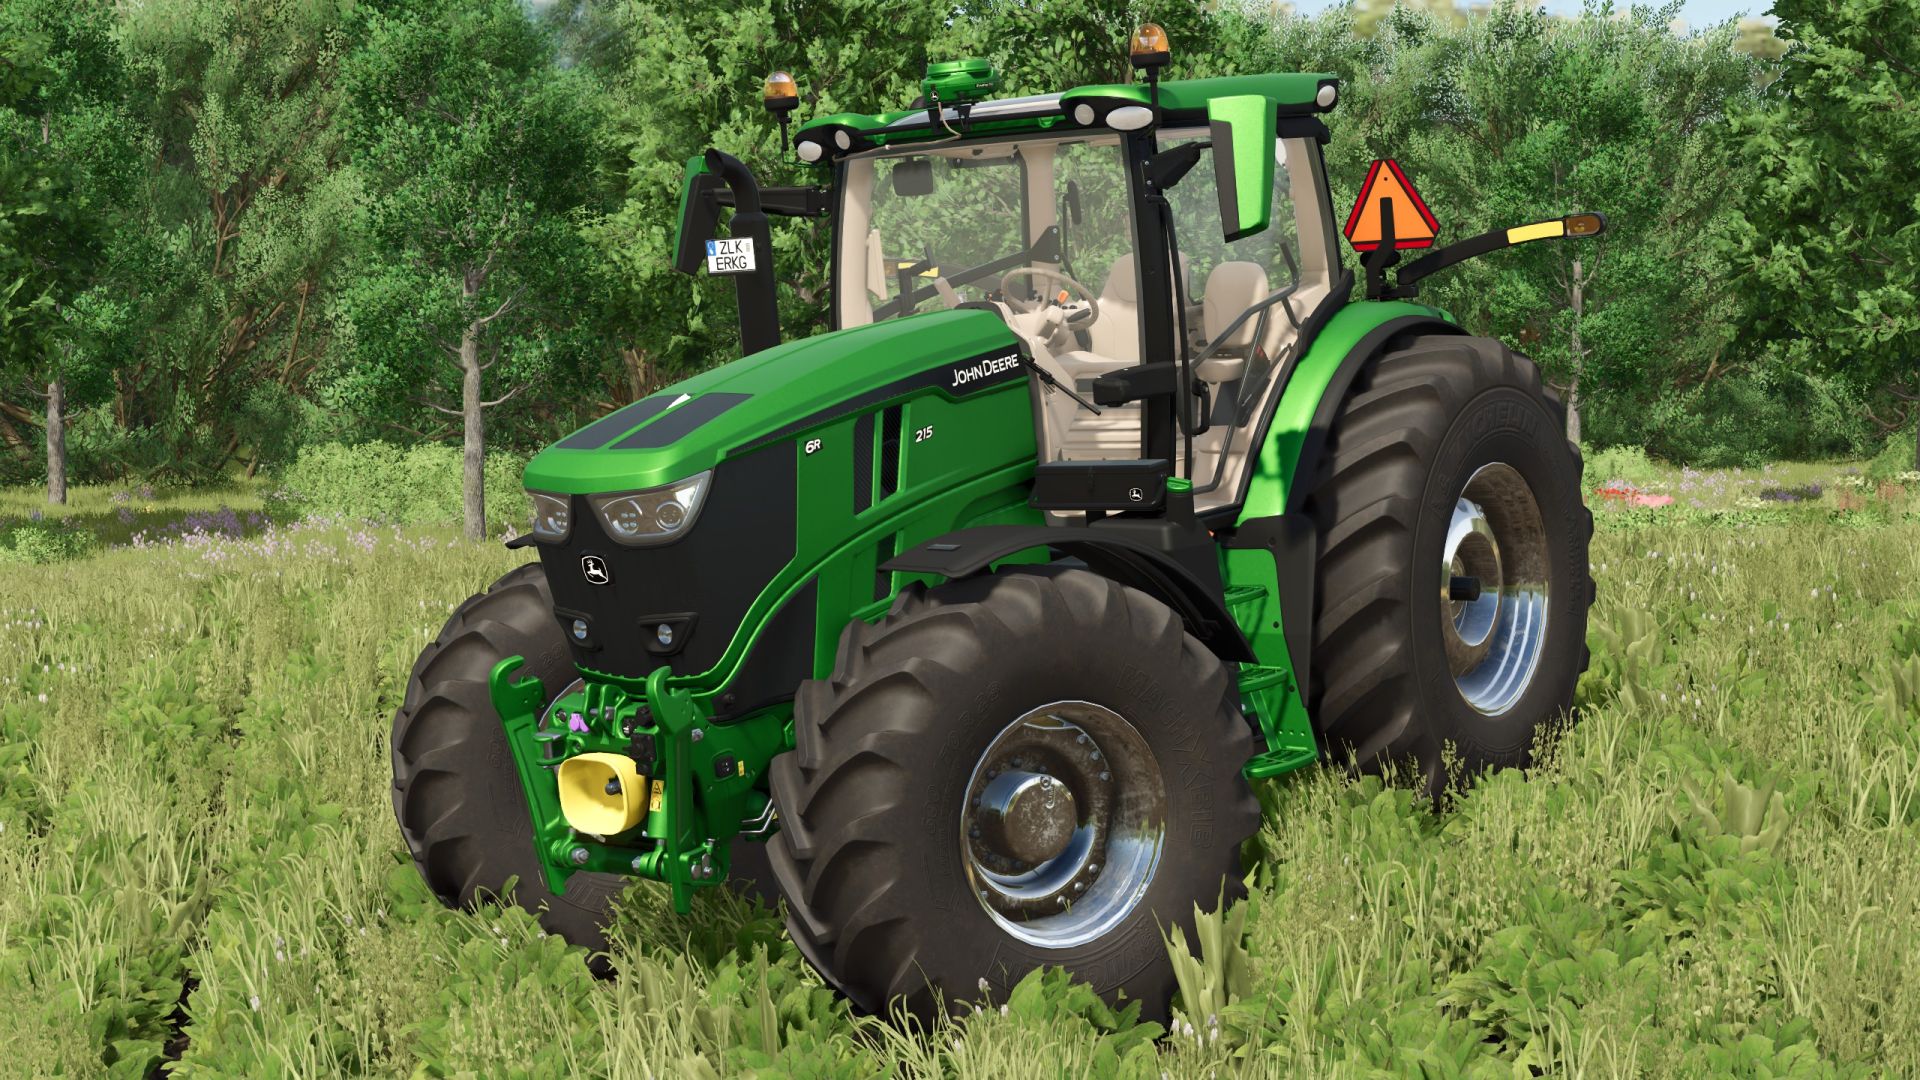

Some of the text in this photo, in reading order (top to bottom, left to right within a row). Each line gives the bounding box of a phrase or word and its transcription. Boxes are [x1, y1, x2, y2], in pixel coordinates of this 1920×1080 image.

[719, 240, 743, 255] ZLK
[716, 255, 747, 271] ERKG
[952, 353, 1019, 387] JOHN DEERE
[915, 425, 933, 443] 215
[805, 438, 821, 454] 6R
